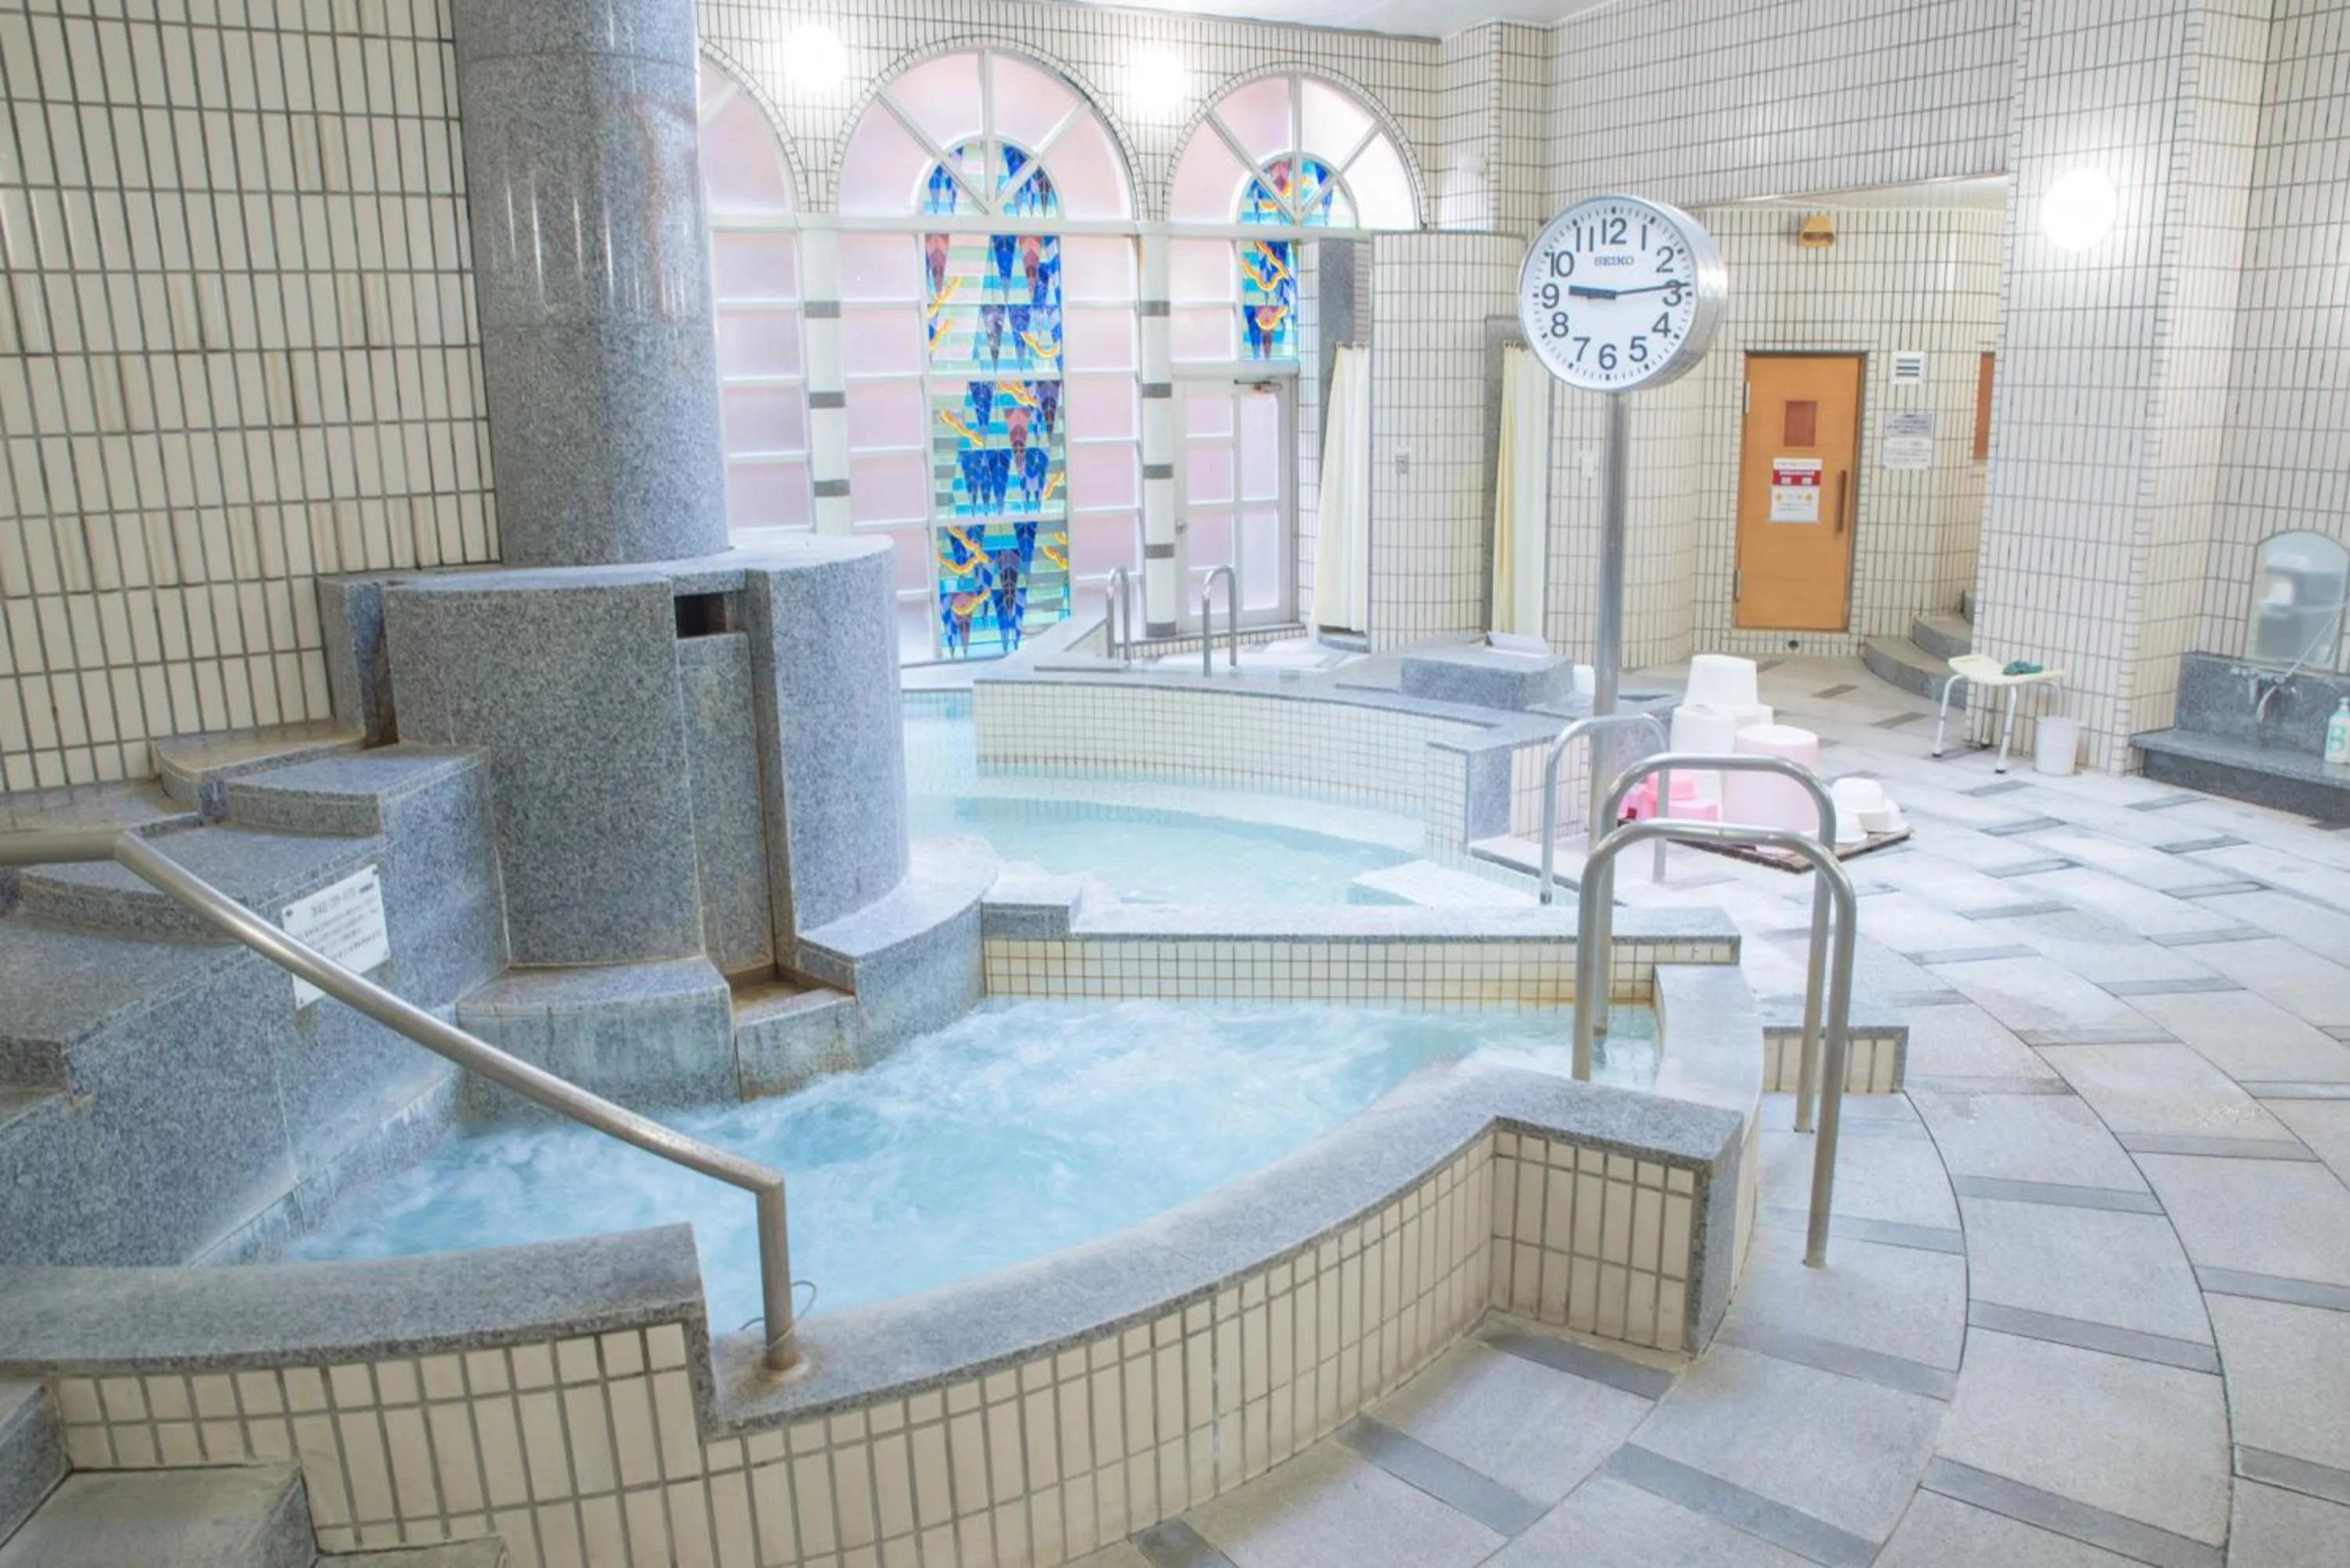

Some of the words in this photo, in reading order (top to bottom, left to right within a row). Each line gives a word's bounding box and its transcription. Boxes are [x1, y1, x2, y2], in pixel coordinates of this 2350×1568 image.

[1576, 226, 1593, 252] 11
[1602, 218, 1627, 244] 12
[1641, 224, 1647, 251] 1
[1550, 251, 1574, 276] 10
[1594, 256, 1635, 266] SEIKO
[1655, 246, 1674, 273] 2
[1541, 284, 1560, 309] 9
[1662, 280, 1682, 306] 3
[1551, 312, 1569, 338] 8
[1652, 312, 1672, 338] 4
[1573, 337, 1590, 361] 7
[1599, 344, 1617, 370] 6
[1629, 336, 1647, 362] 5
